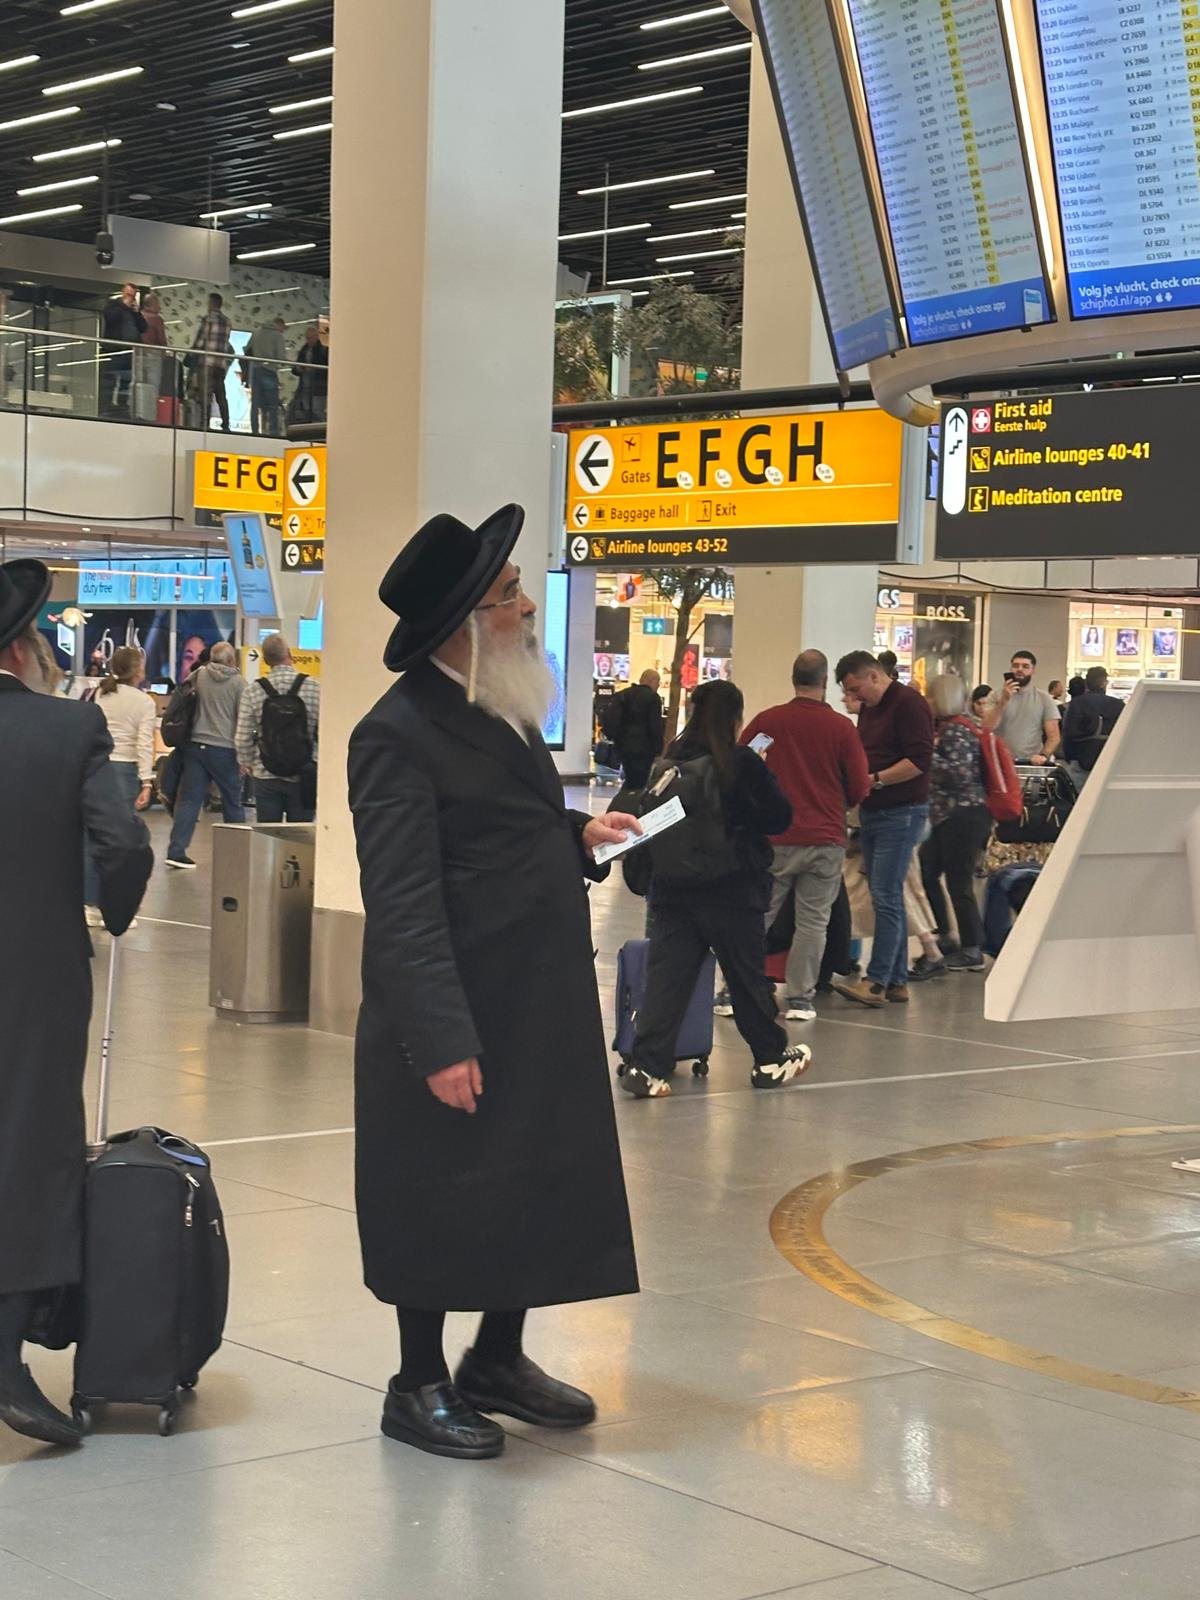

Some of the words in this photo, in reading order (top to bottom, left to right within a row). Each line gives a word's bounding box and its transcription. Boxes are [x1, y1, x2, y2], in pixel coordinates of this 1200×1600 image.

[1079, 285, 1102, 298] Volg
[1104, 284, 1112, 297] je
[1115, 280, 1148, 292] vlucht,
[1151, 276, 1180, 290] check
[1080, 294, 1152, 310] schiphol.nl/app
[995, 402, 1026, 419] First
[1030, 398, 1052, 416] aid
[995, 421, 1023, 433] Eerste
[1025, 419, 1047, 433] hulp
[994, 448, 1041, 466] Airline
[1046, 446, 1104, 466] lounges
[1108, 442, 1150, 460] 40-41
[622, 470, 650, 484] Gates
[992, 487, 1071, 506] Meditation
[1076, 487, 1122, 503] centre
[610, 507, 656, 522] Baggage
[660, 505, 678, 518] hall
[716, 502, 736, 516] Exit
[608, 539, 646, 554] Airline
[648, 538, 692, 556] lounges
[695, 538, 728, 553] 43-52
[926, 605, 965, 620] BOSS
